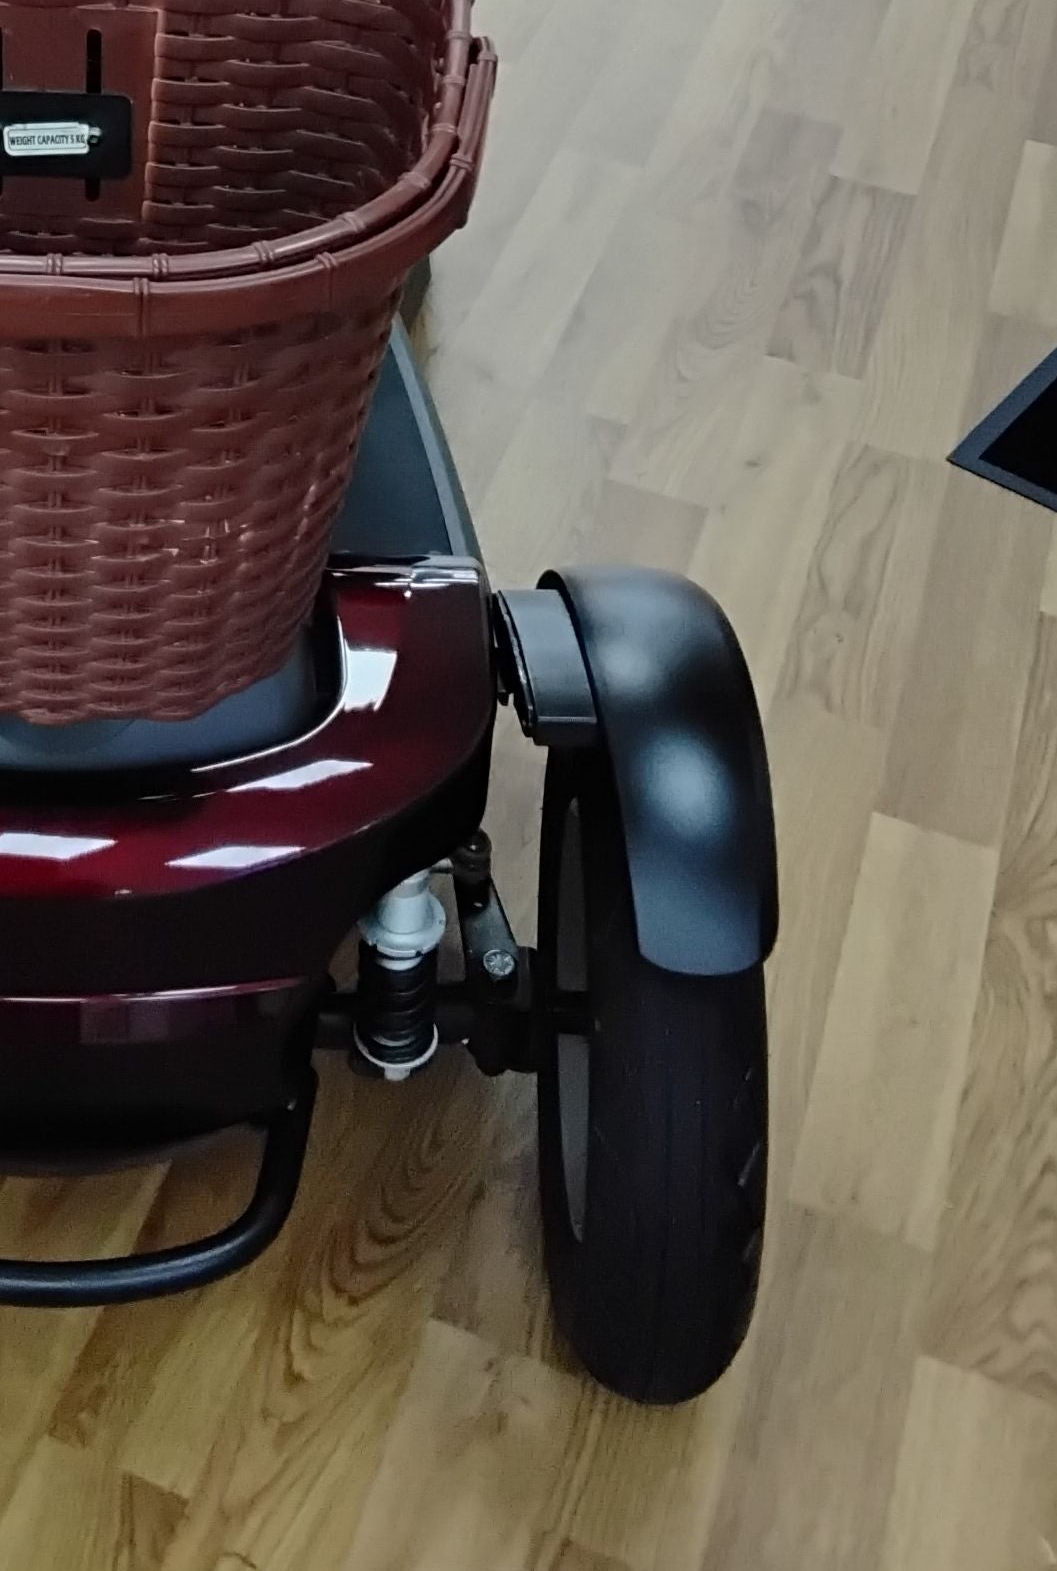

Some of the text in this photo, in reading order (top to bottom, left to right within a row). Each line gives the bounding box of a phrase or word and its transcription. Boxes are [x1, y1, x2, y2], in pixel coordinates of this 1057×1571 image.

[10, 135, 36, 146] WEIGHT
[37, 134, 69, 145] CAPACITY
[70, 134, 75, 143] 5
